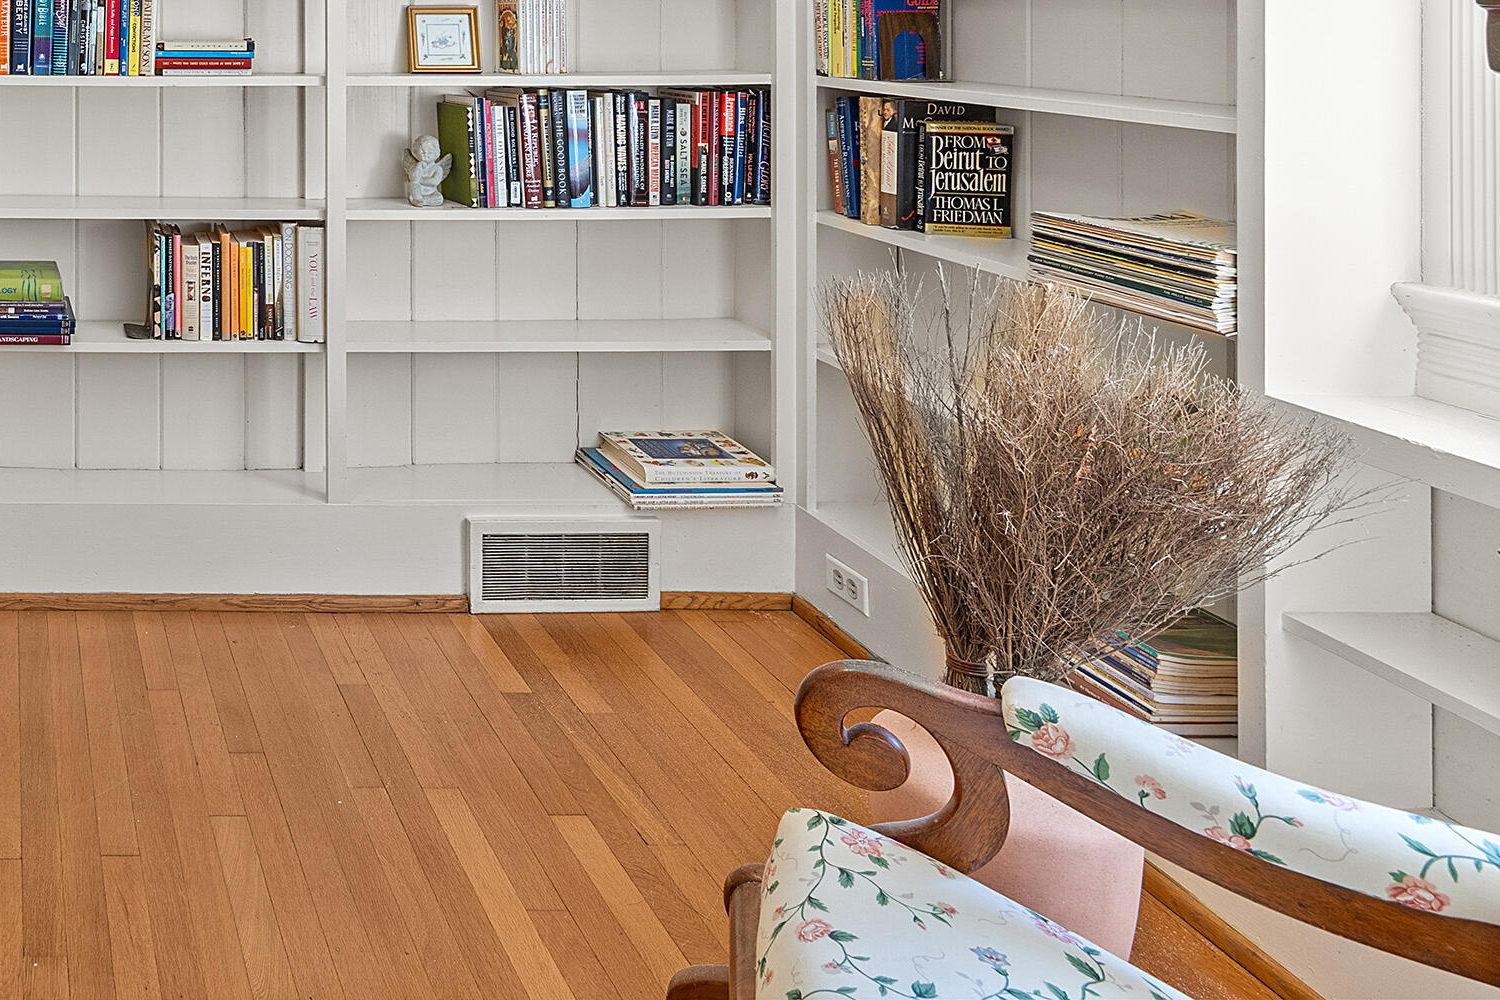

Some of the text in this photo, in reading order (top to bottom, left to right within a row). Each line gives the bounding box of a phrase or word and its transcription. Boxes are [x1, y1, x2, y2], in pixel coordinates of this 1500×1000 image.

[37, 8, 49, 25] BIBLE
[143, 0, 153, 34] FATHER,
[142, 50, 151, 67] SON
[144, 34, 152, 49] MY
[723, 97, 735, 132] Arrogance
[927, 103, 965, 115] DAVID
[616, 114, 626, 172] MAKING WAVES
[666, 109, 674, 148] MARK LEVIN
[838, 114, 846, 150] AMERICAN
[944, 135, 986, 149] FROM
[496, 141, 504, 184] ODYSSEY
[524, 142, 530, 152] AN
[531, 132, 539, 167] REPUBLIC,
[556, 119, 567, 195] THE GOOD BOOK
[651, 105, 659, 193] MARK LEVIN AMERICAN MARXISM
[680, 139, 688, 186] SALT SEA
[759, 120, 770, 193] LIGHT GLORY
[930, 135, 984, 171] Beirut
[986, 156, 1008, 168] TO
[524, 153, 532, 178] EMPIRE
[928, 169, 1007, 200] Jerusalem
[933, 196, 991, 209] THOMAS
[933, 211, 1002, 224] FRIEDMAN
[284, 227, 293, 290] ON DOCTORING
[201, 251, 211, 303] INFERNO
[308, 253, 318, 320] YOU LAW
